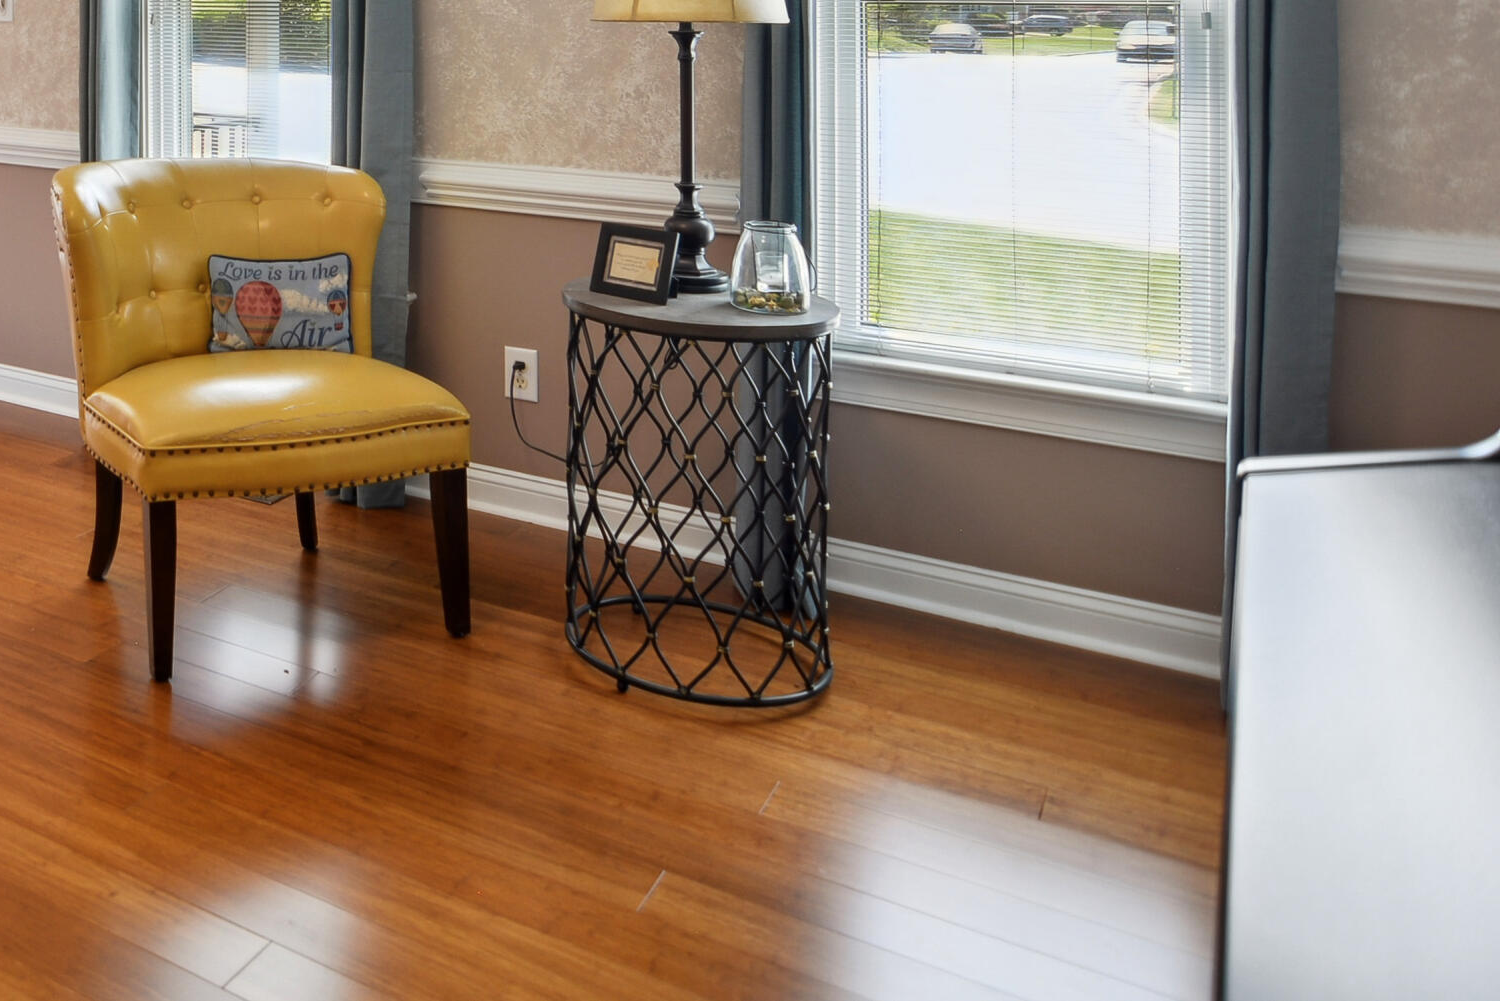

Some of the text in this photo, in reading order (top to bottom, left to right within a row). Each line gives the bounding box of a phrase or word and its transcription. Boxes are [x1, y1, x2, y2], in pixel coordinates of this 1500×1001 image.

[218, 261, 339, 282] Love is in the
[280, 319, 332, 349] Air
